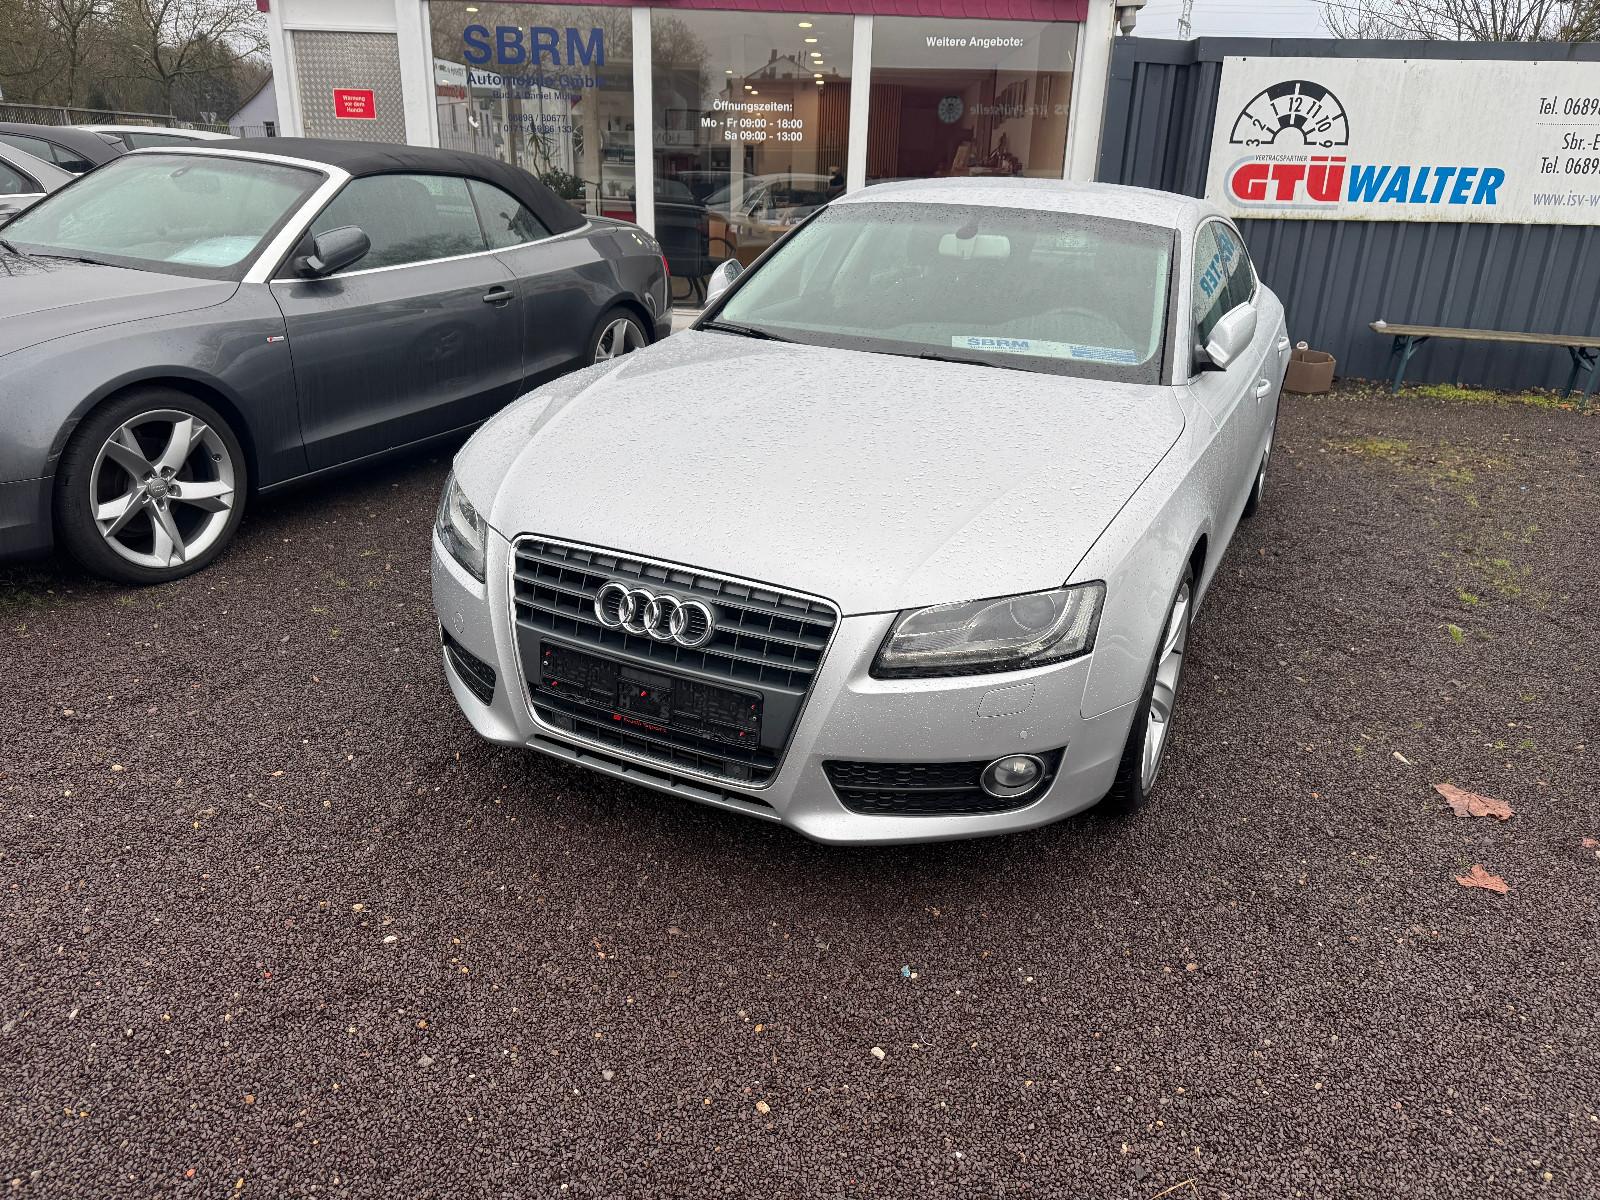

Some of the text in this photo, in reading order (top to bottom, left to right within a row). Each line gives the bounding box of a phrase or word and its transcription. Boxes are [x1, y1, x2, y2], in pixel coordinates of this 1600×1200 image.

[463, 24, 605, 66] SBRM
[926, 36, 1024, 49] Weitere Angebote:
[713, 99, 793, 113] Öffnungszeiten:
[1289, 97, 1303, 112] 12
[1306, 100, 1323, 119] 11
[1539, 96, 1600, 115] Tel. 0689
[701, 117, 717, 128] Mo
[727, 117, 738, 128] Fr
[740, 118, 767, 128] 09:00
[776, 119, 803, 129] 18:00
[1315, 114, 1332, 133] 10
[724, 131, 738, 140] Sa
[740, 131, 767, 141] 09:00
[776, 131, 803, 141] 13:00
[1255, 154, 1308, 162] VERTRAGSPARTNER
[1540, 156, 1600, 175] Tel. 0689
[1232, 154, 1506, 205] GTÜ WALTER
[967, 338, 1030, 348] SBRM
